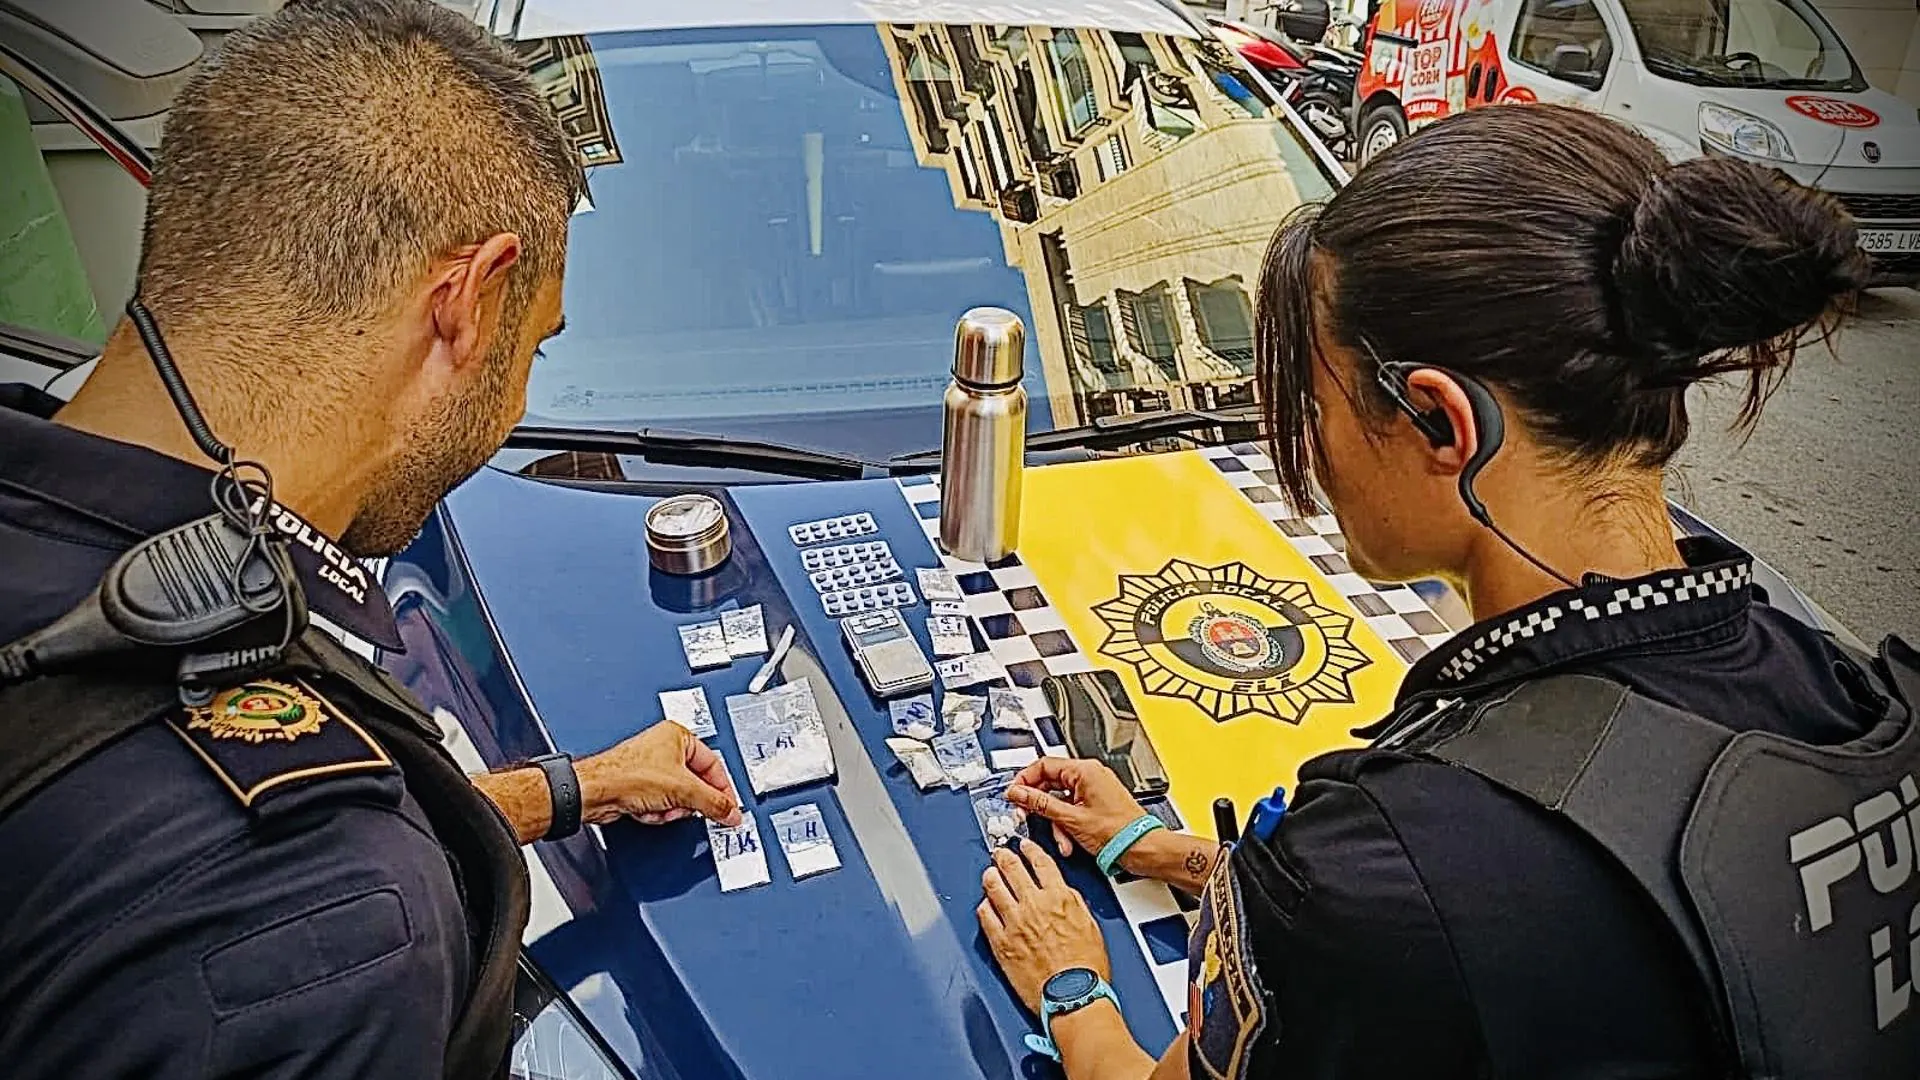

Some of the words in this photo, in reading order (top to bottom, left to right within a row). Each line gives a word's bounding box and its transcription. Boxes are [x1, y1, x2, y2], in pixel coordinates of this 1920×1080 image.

[1413, 47, 1442, 71] TOP
[1410, 69, 1440, 87] CORN
[1862, 232, 1894, 249] 7585
[317, 563, 365, 605] LOCAL
[1140, 584, 1201, 625] POLICIA
[1211, 582, 1285, 611] LOCAL
